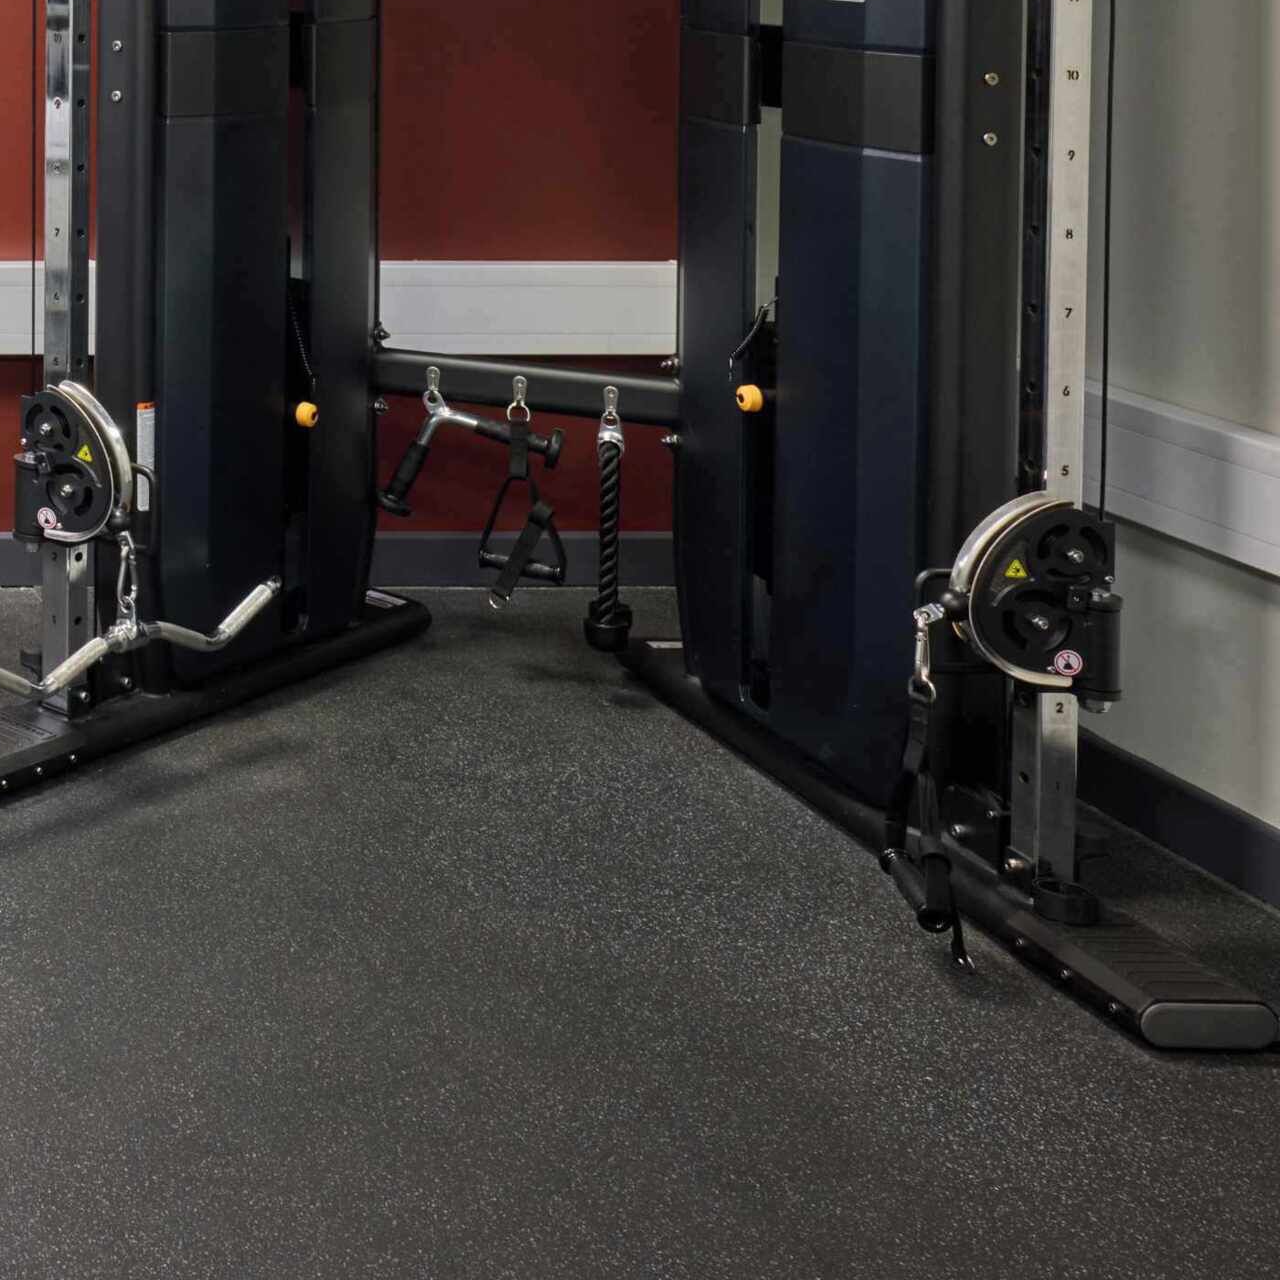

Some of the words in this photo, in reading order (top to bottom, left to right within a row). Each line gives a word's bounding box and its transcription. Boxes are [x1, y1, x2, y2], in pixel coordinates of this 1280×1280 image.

[1067, 70, 1080, 81] 10
[1067, 150, 1075, 161] 9
[54, 228, 60, 237] 7
[1065, 229, 1073, 239] 8
[1064, 307, 1073, 318] 7
[1062, 385, 1071, 396] 6
[1061, 465, 1069, 476] 5
[1055, 703, 1064, 713] 2
